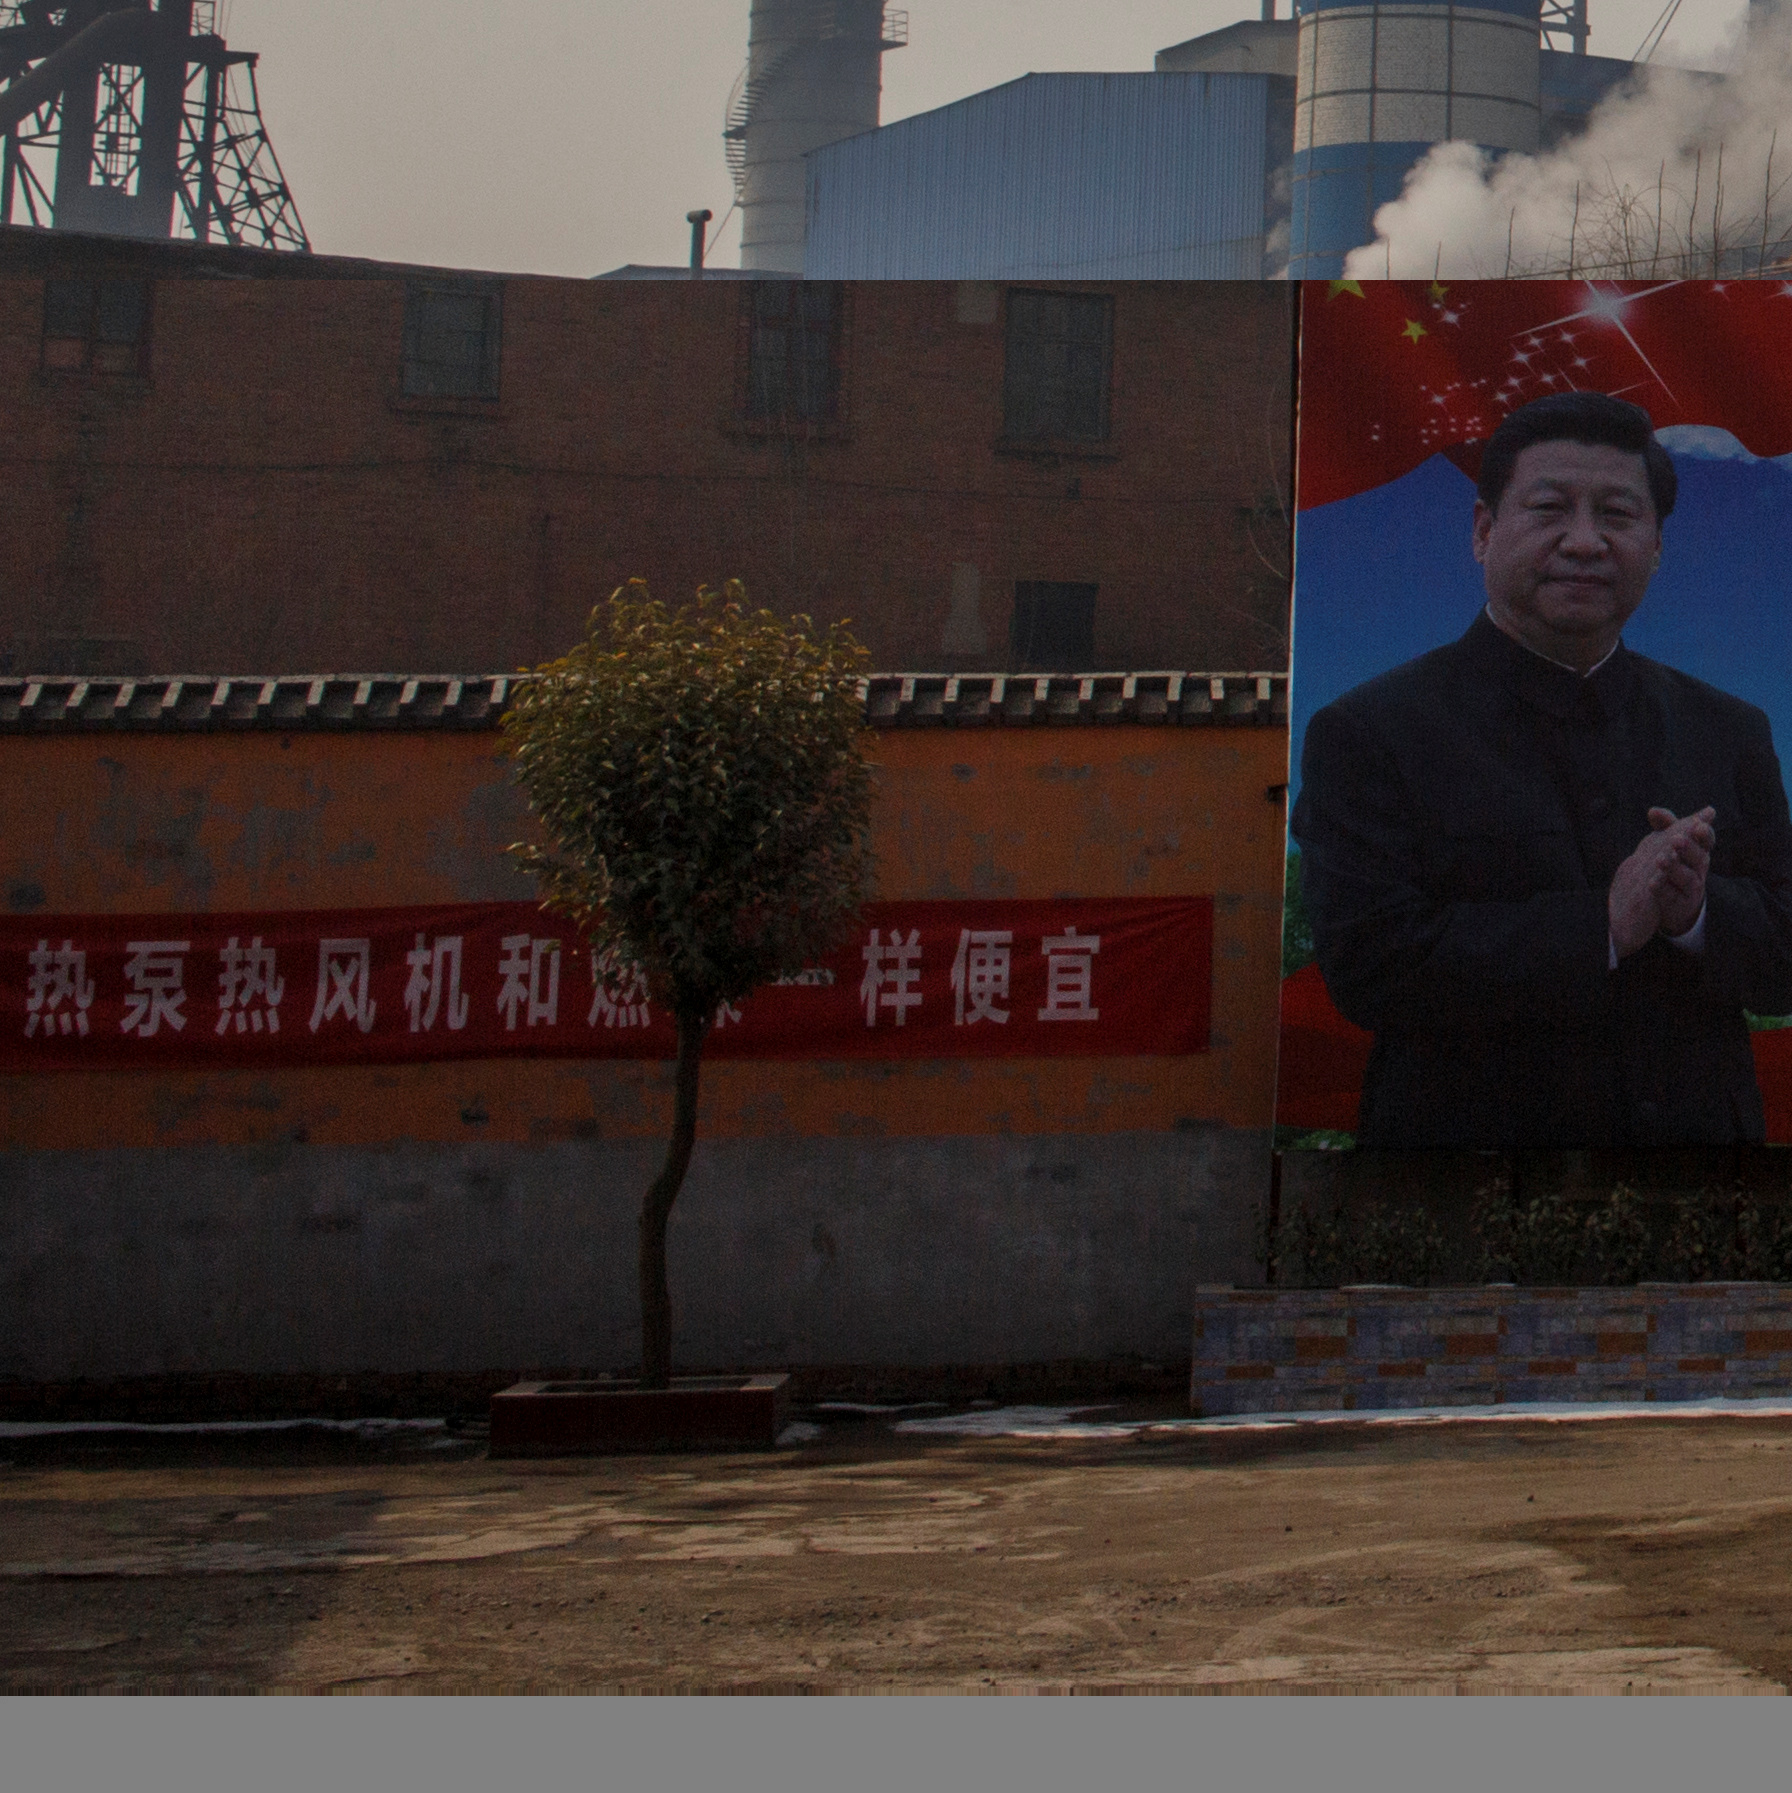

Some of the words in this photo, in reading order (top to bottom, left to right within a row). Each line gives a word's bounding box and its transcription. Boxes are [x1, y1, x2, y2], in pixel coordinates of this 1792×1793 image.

[24, 926, 1101, 1038] 热泵热风机和燃一样便宜
